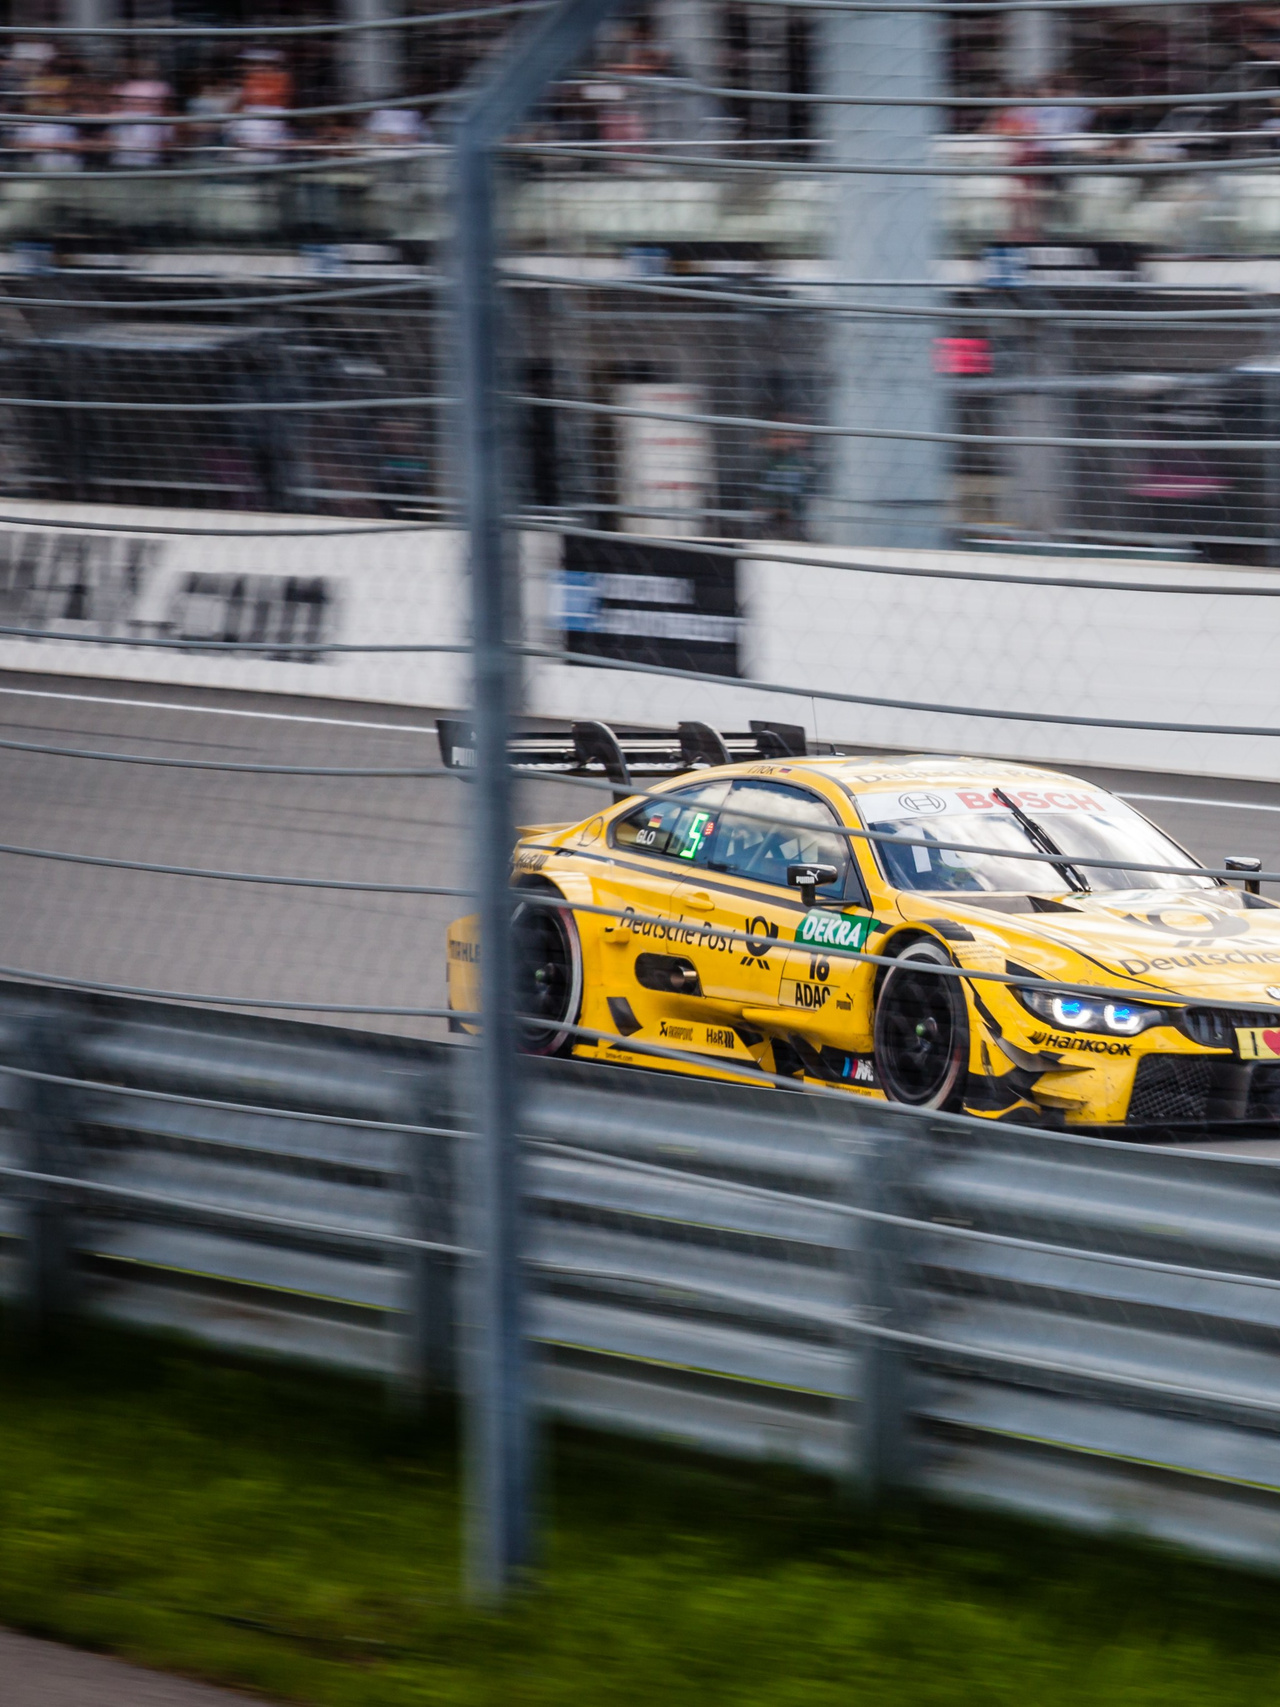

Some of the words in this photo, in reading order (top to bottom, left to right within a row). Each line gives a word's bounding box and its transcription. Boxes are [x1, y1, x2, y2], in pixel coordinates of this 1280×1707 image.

[955, 790, 1106, 812] BOSCH
[636, 829, 656, 845] GLO
[795, 875, 815, 885] PUMA
[619, 906, 697, 946] Deutsche
[698, 920, 737, 954] Post
[802, 915, 862, 948] DEKRA
[809, 952, 830, 982] 16
